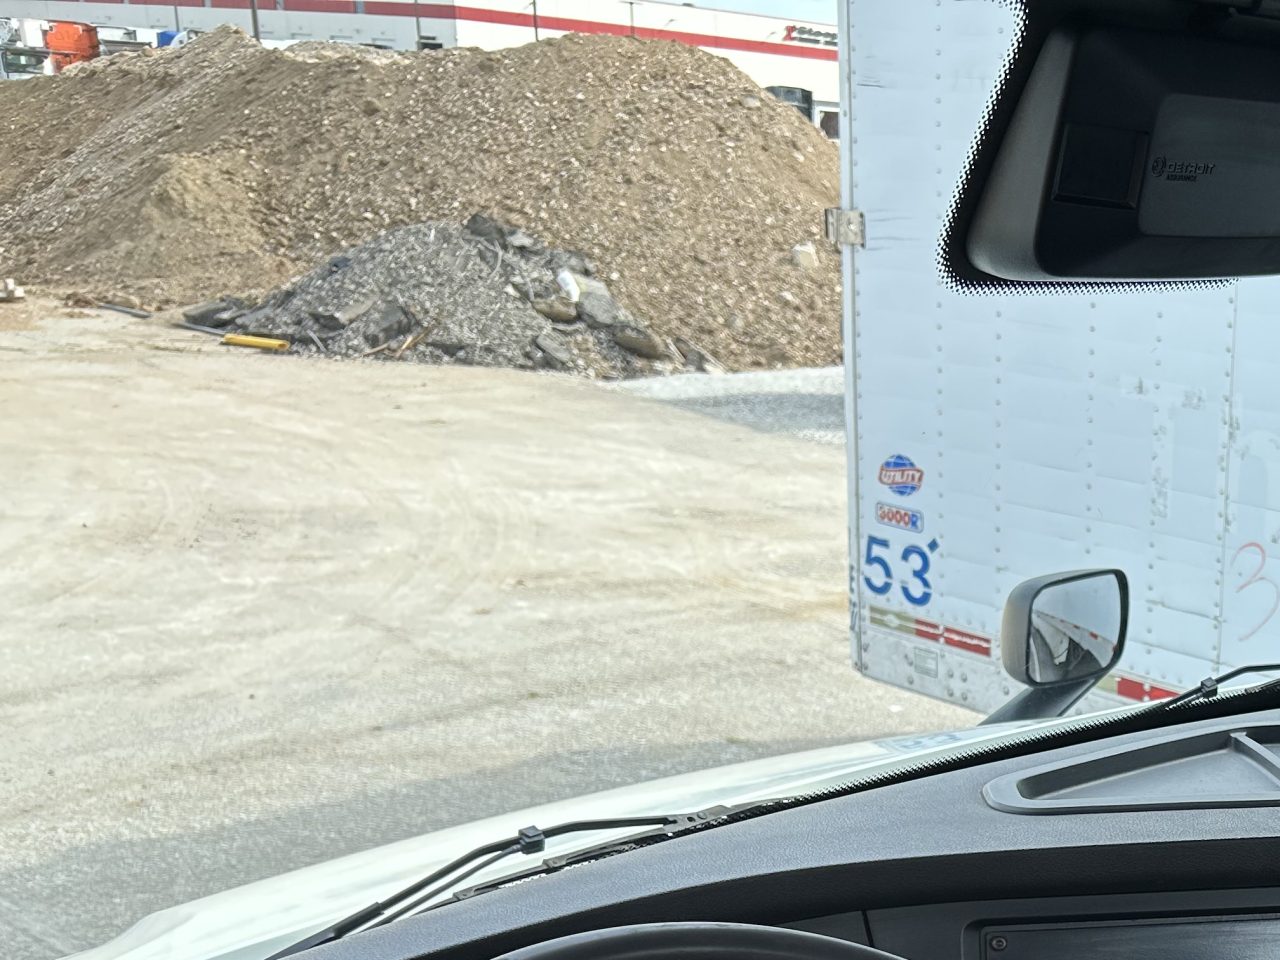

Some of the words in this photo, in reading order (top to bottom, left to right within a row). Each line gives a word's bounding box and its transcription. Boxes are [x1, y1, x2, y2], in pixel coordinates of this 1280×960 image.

[1167, 162, 1216, 175] DETROIT
[880, 469, 922, 485] UTILITY
[879, 505, 920, 531] 3000R
